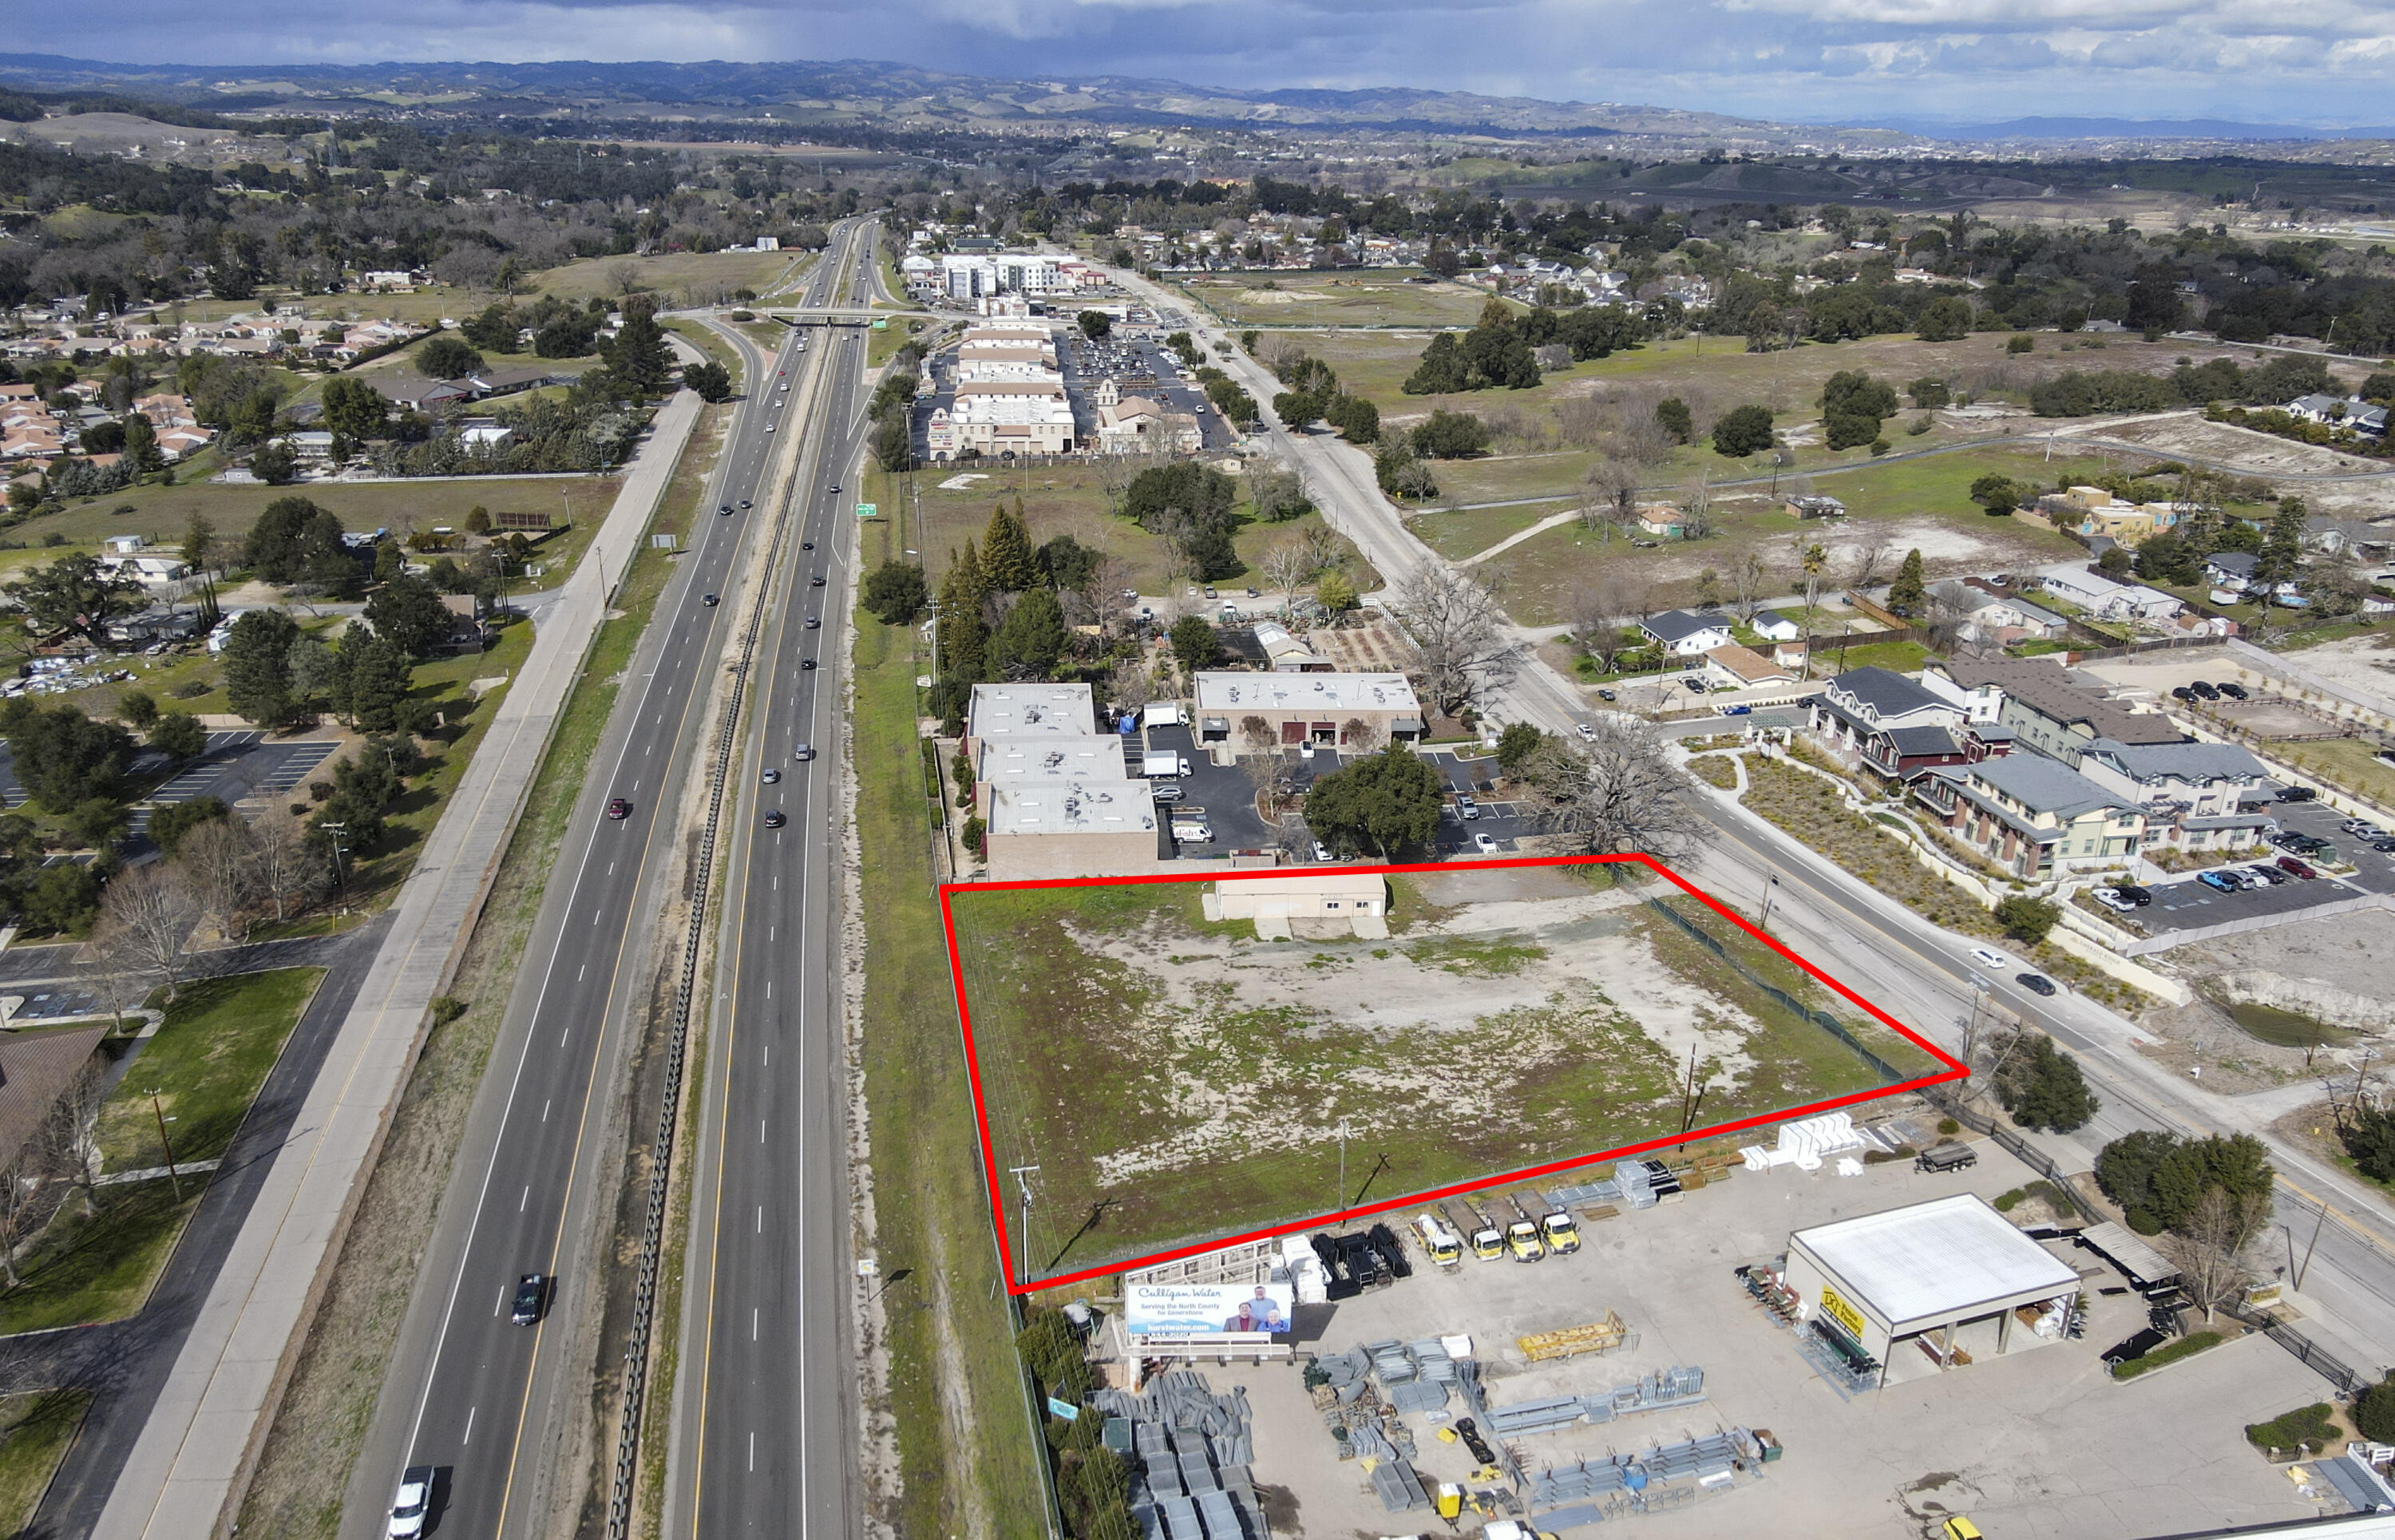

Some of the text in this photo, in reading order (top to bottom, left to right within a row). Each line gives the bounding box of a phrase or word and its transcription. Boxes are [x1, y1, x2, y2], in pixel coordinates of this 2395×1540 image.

[1138, 1287, 1221, 1301] Culligan Water
[1842, 1303, 1858, 1321] Fence
[1840, 1311, 1861, 1334] Factory
